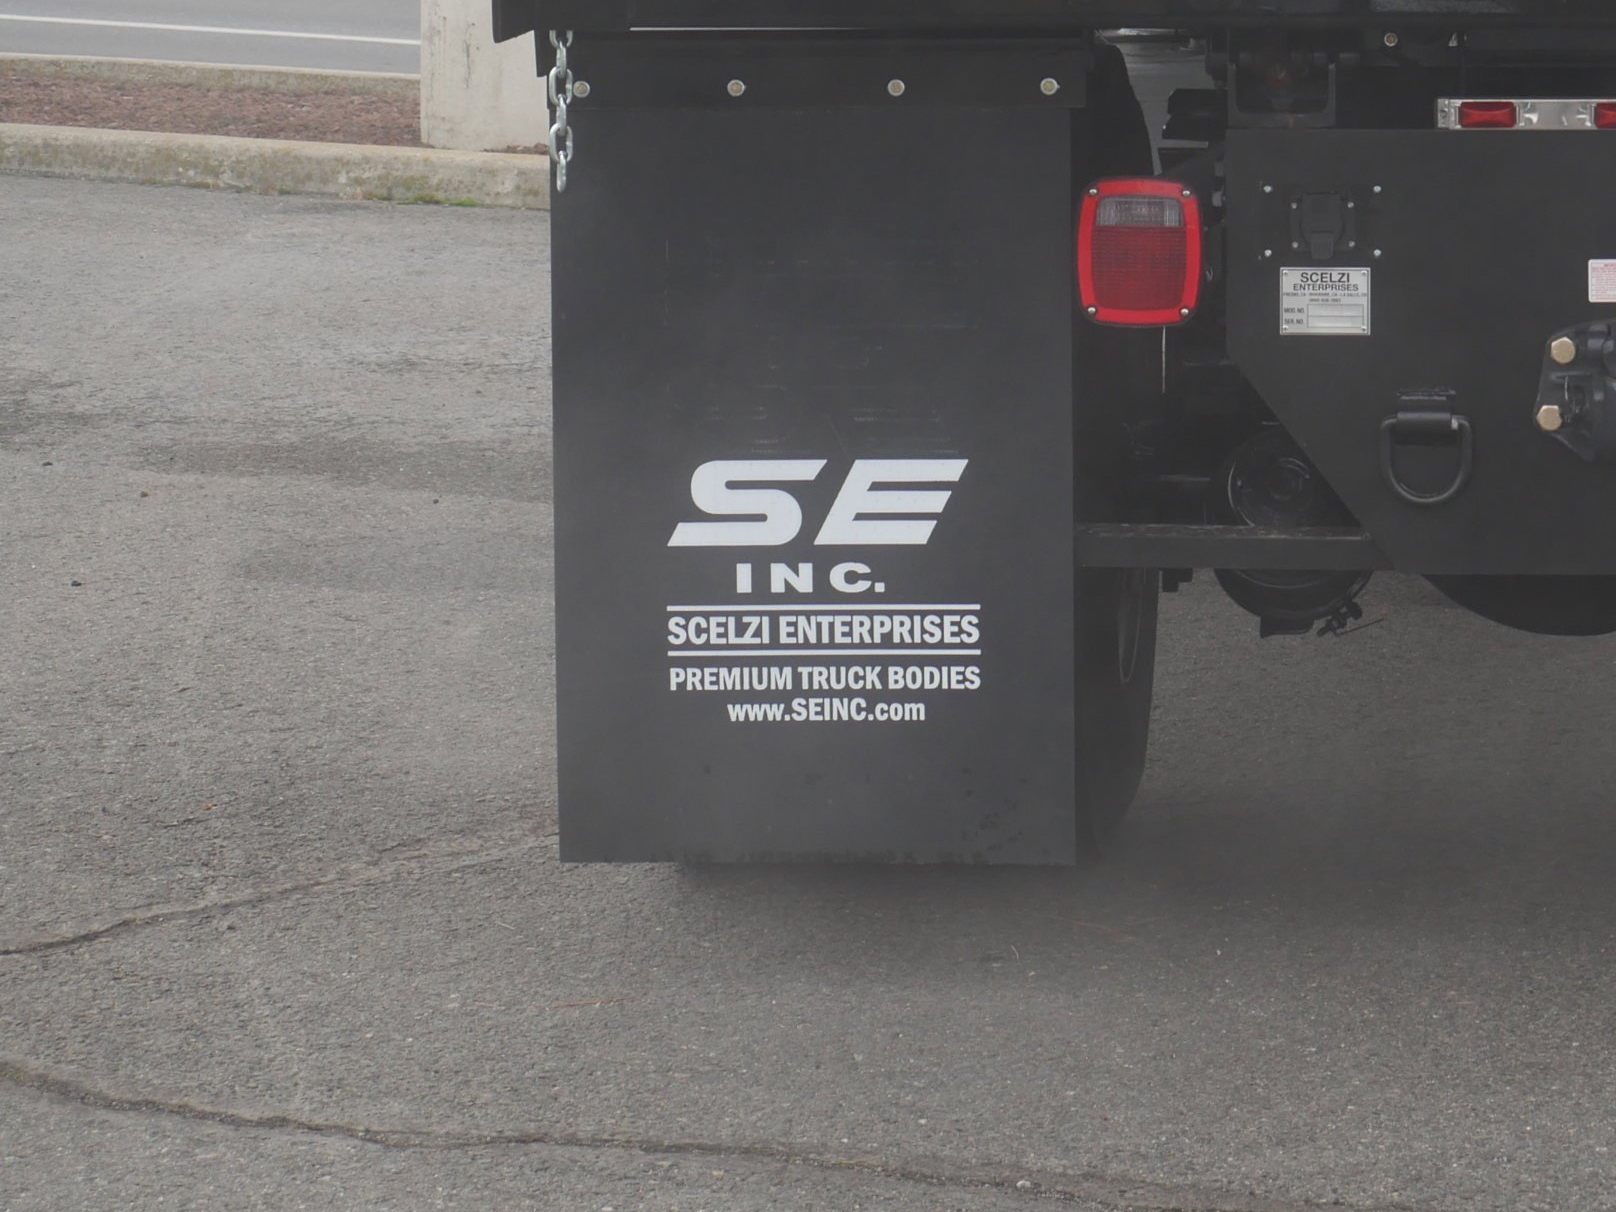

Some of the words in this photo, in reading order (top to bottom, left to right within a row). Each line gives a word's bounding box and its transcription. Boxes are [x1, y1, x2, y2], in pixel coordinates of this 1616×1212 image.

[1293, 283, 1359, 292] ENTERPRISES
[1300, 272, 1350, 283] SCELZI
[667, 458, 969, 547] SE
[736, 561, 885, 593] INC.
[667, 616, 770, 645] SCELZI
[779, 615, 980, 644] ENTERPRISES
[669, 666, 793, 691] PREMIUM
[797, 666, 883, 690] TRUCK
[888, 665, 982, 690] BODIES
[727, 697, 926, 721] www.SEINC.com
